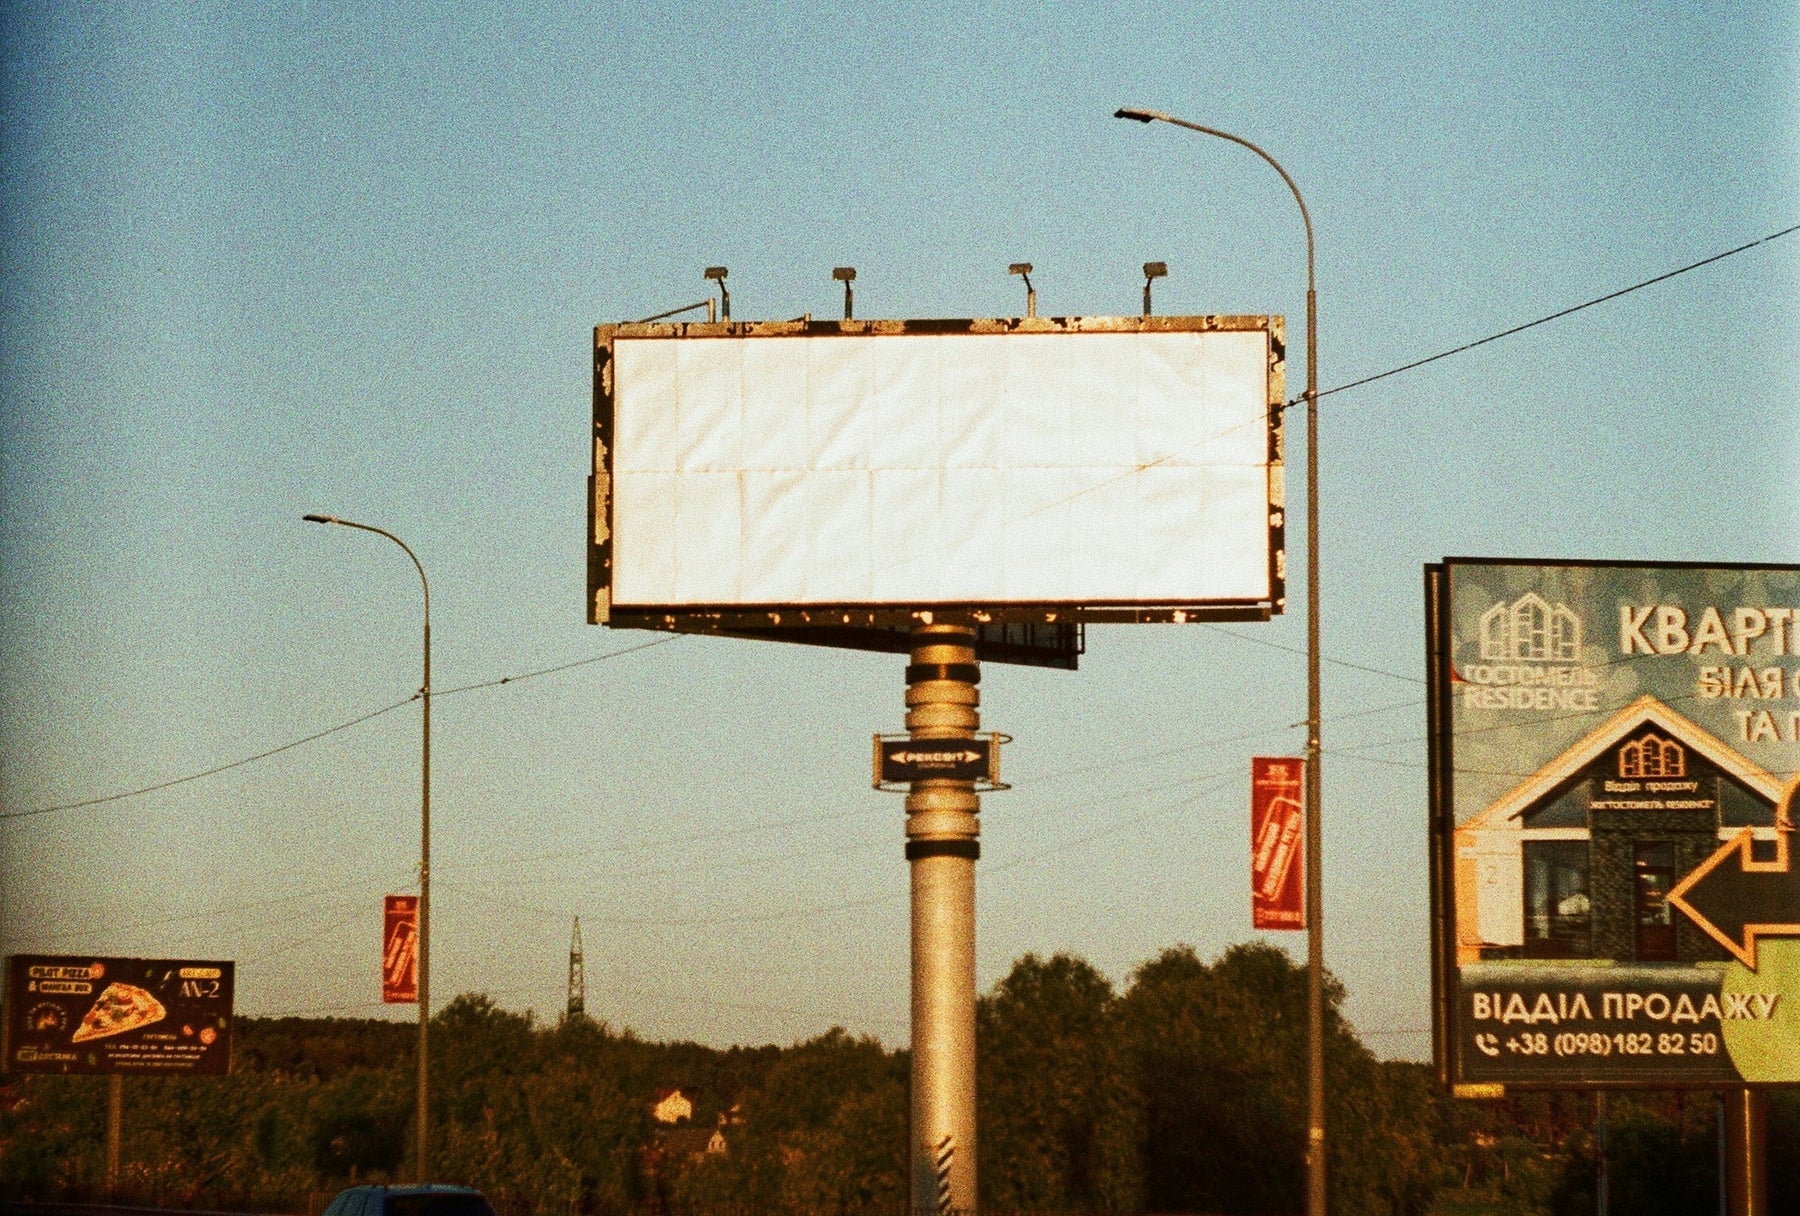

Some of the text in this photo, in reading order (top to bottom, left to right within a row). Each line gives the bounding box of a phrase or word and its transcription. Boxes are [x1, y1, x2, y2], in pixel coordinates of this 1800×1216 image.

[1619, 606, 1800, 656] КВАРТ
[1463, 686, 1599, 711] RESIDENCE
[1698, 666, 1785, 699] БІЛЯ
[1734, 709, 1781, 742] ТА
[62, 968, 90, 979] PIZZA
[1472, 992, 1782, 1024] ВІДДІЛ ПРОДАЖУ
[1505, 1032, 1549, 1056] +38
[1657, 1033, 1685, 1056] 82
[1689, 1033, 1718, 1056] 50
